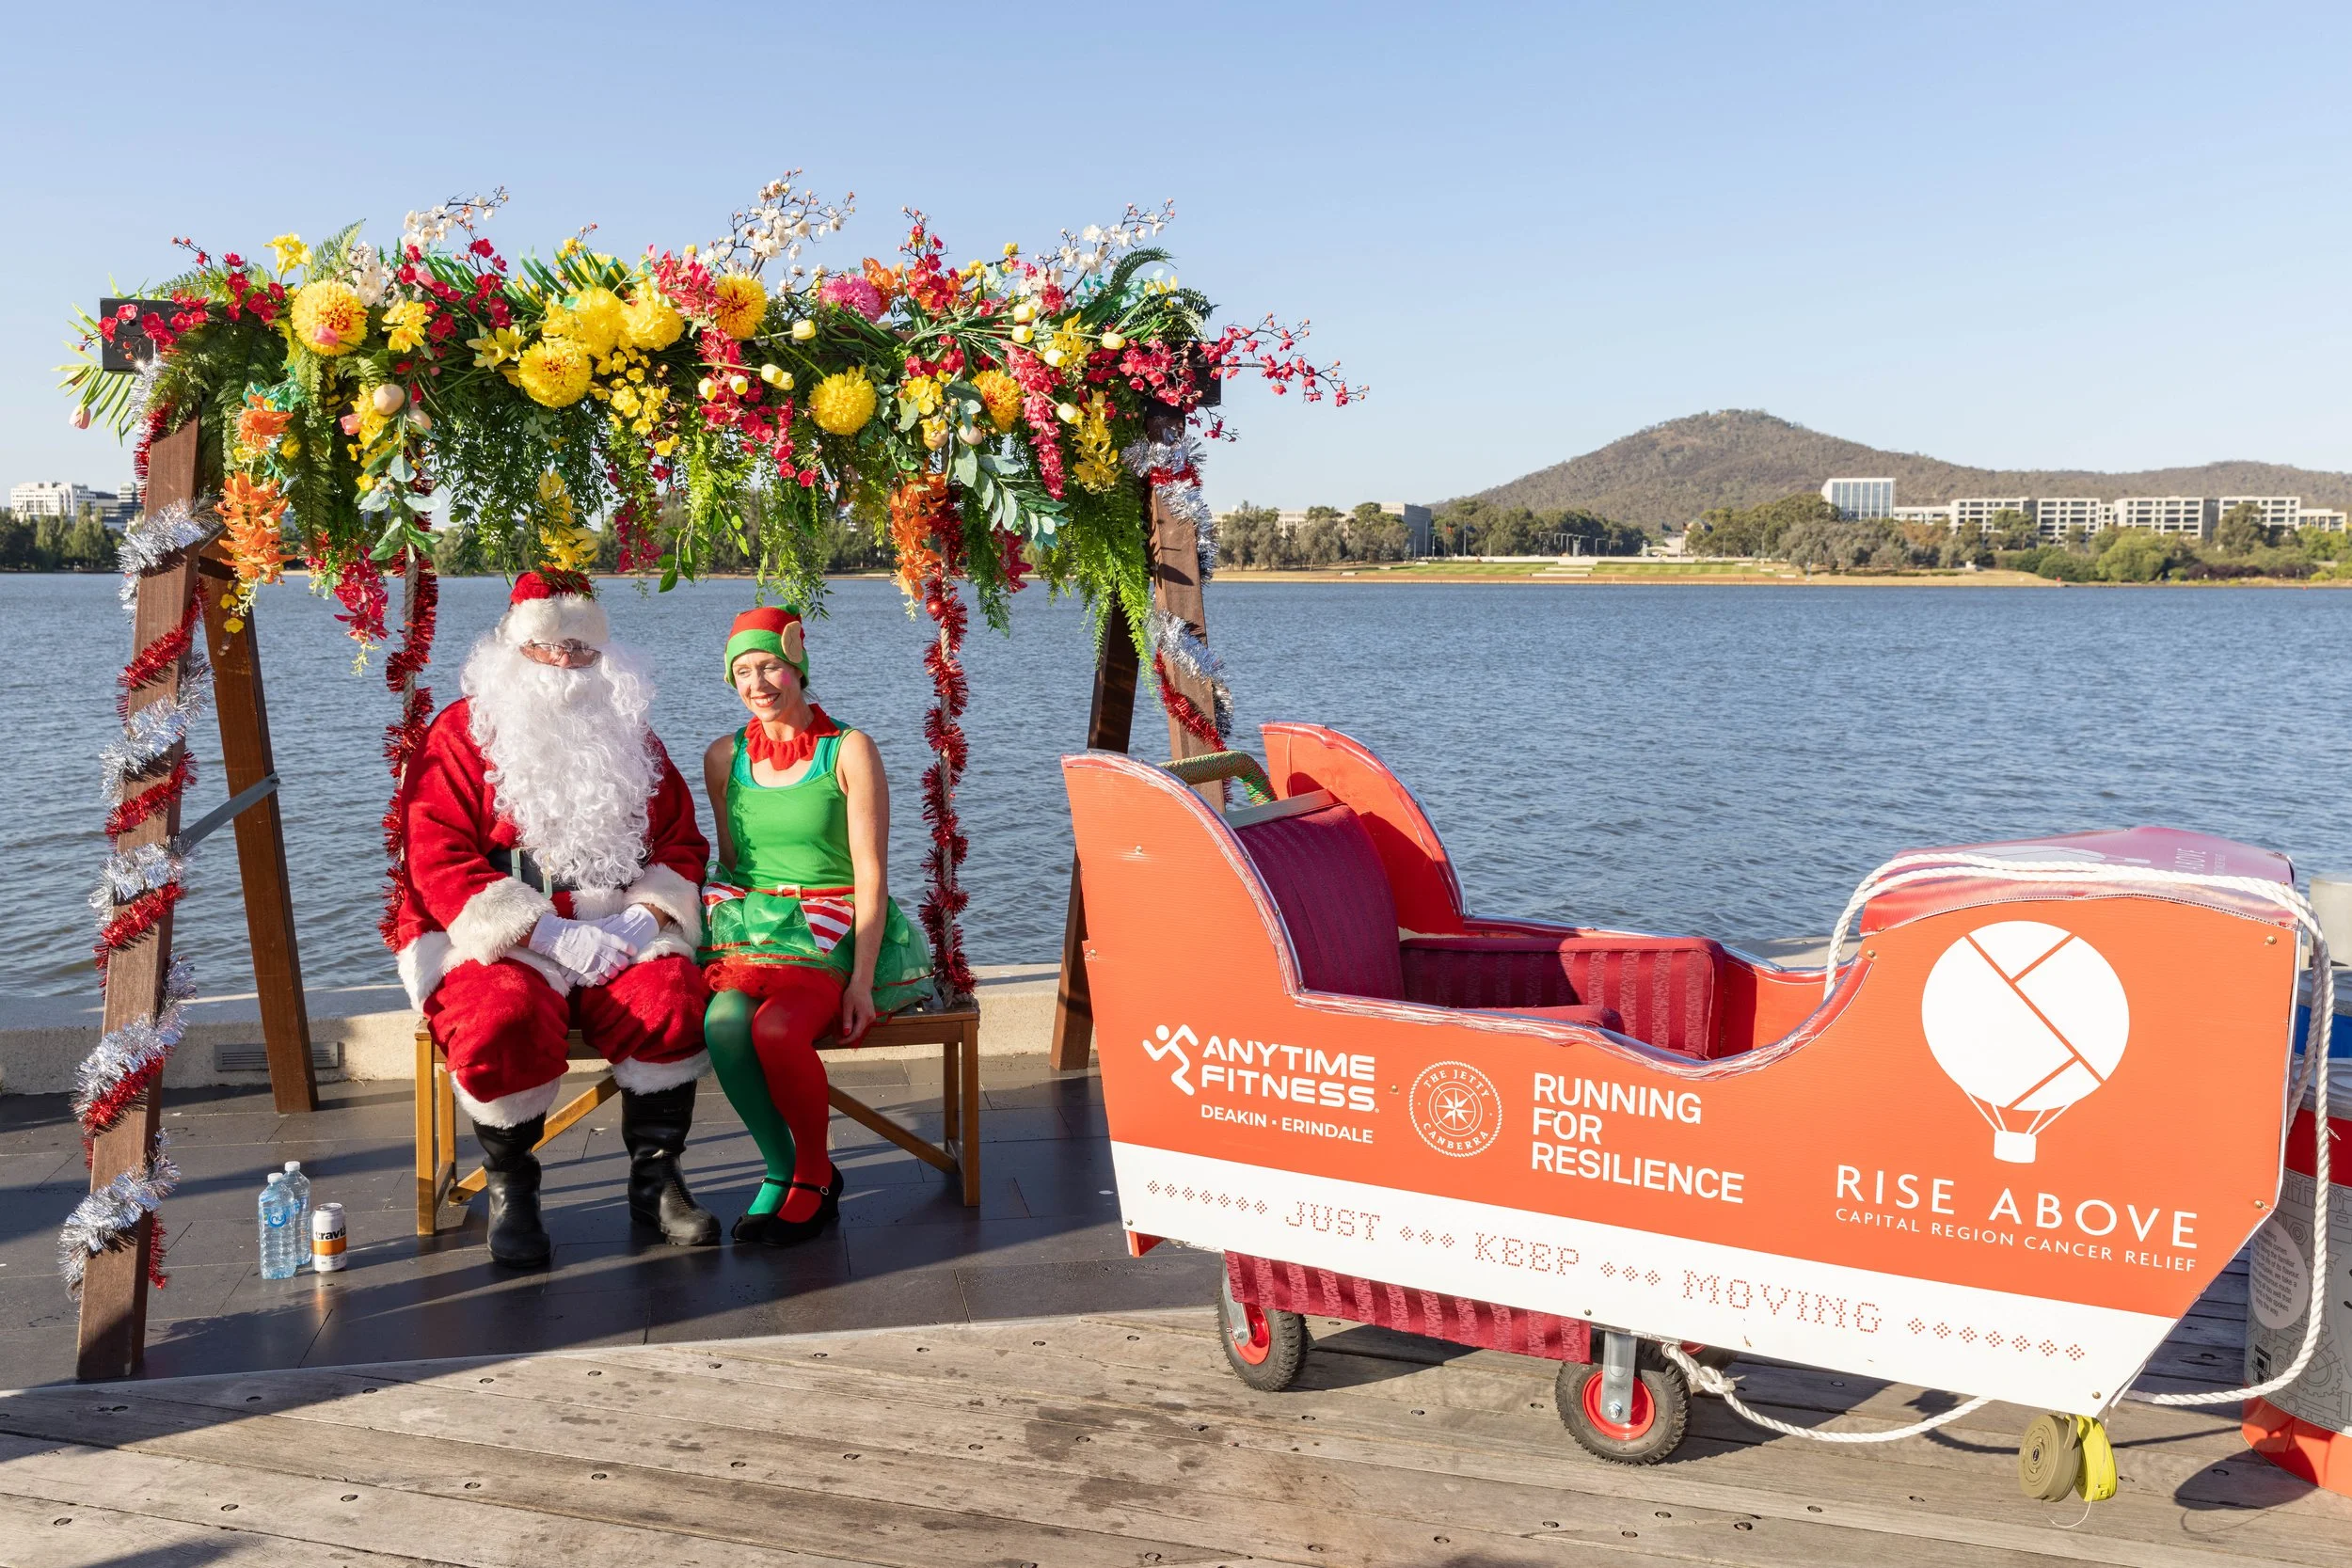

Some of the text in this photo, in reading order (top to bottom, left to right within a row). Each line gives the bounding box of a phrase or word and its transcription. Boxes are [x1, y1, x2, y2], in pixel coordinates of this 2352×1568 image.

[1202, 1035, 1375, 1082] ANYTIME
[1200, 1064, 1375, 1112] FITNESS
[1423, 1069, 1490, 1098] THE JETTY
[1534, 1071, 1702, 1125] RUNNING
[1200, 1103, 1374, 1144] DEAKIN ERINDALE
[1422, 1122, 1488, 1150] CANBERRA
[1533, 1106, 1603, 1146] FOR
[1532, 1141, 1745, 1204] RESILIENCE
[1836, 1164, 2198, 1249] RISE ABOVE
[1836, 1208, 2196, 1272] CAPITAL REGION CANCER RELIEF
[1285, 1200, 1883, 1334] JUST KEEP MOVING
